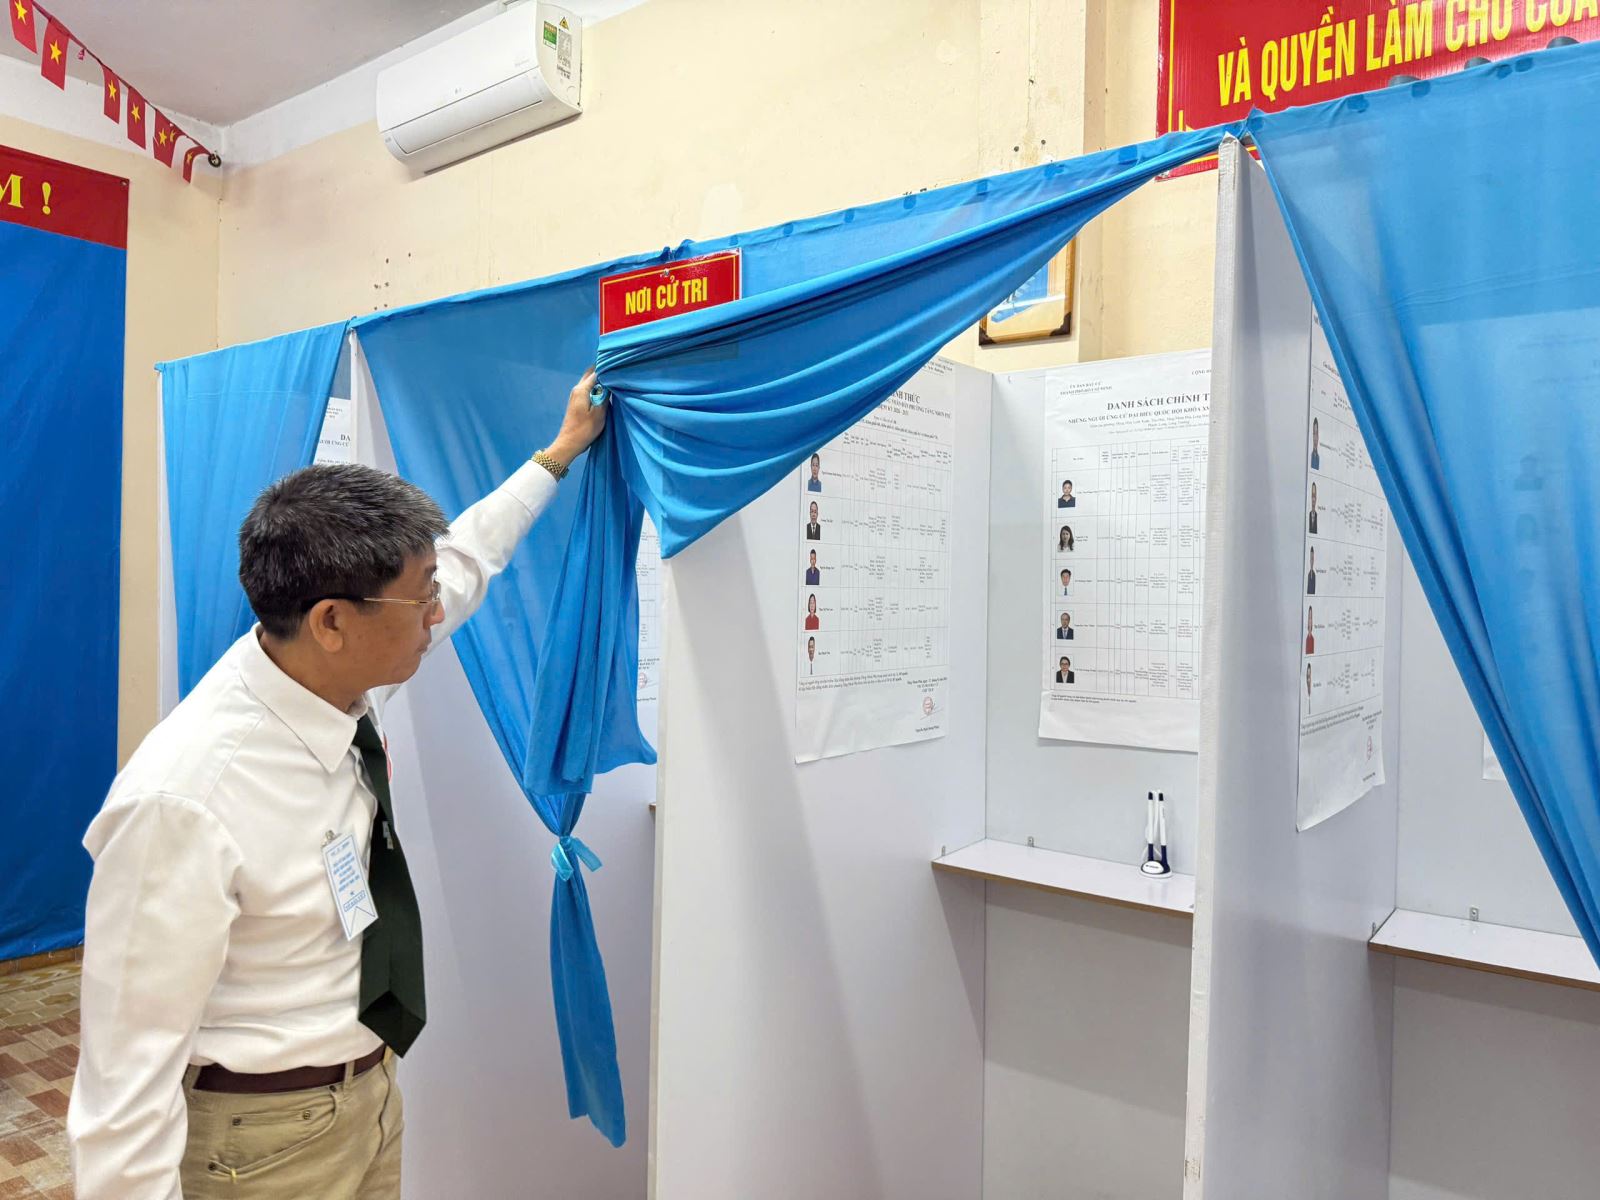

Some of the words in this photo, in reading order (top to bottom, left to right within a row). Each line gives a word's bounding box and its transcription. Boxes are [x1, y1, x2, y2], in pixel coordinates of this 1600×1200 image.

[1218, 38, 1251, 106] VÀ
[1260, 12, 1356, 102] QUYỀN
[625, 287, 651, 315] NƠI
[656, 275, 680, 310] CỬ
[682, 277, 708, 305] TRI
[1107, 400, 1135, 410] DANH
[1137, 396, 1164, 407] SÁCH
[1166, 393, 1200, 404] CHÍNH
